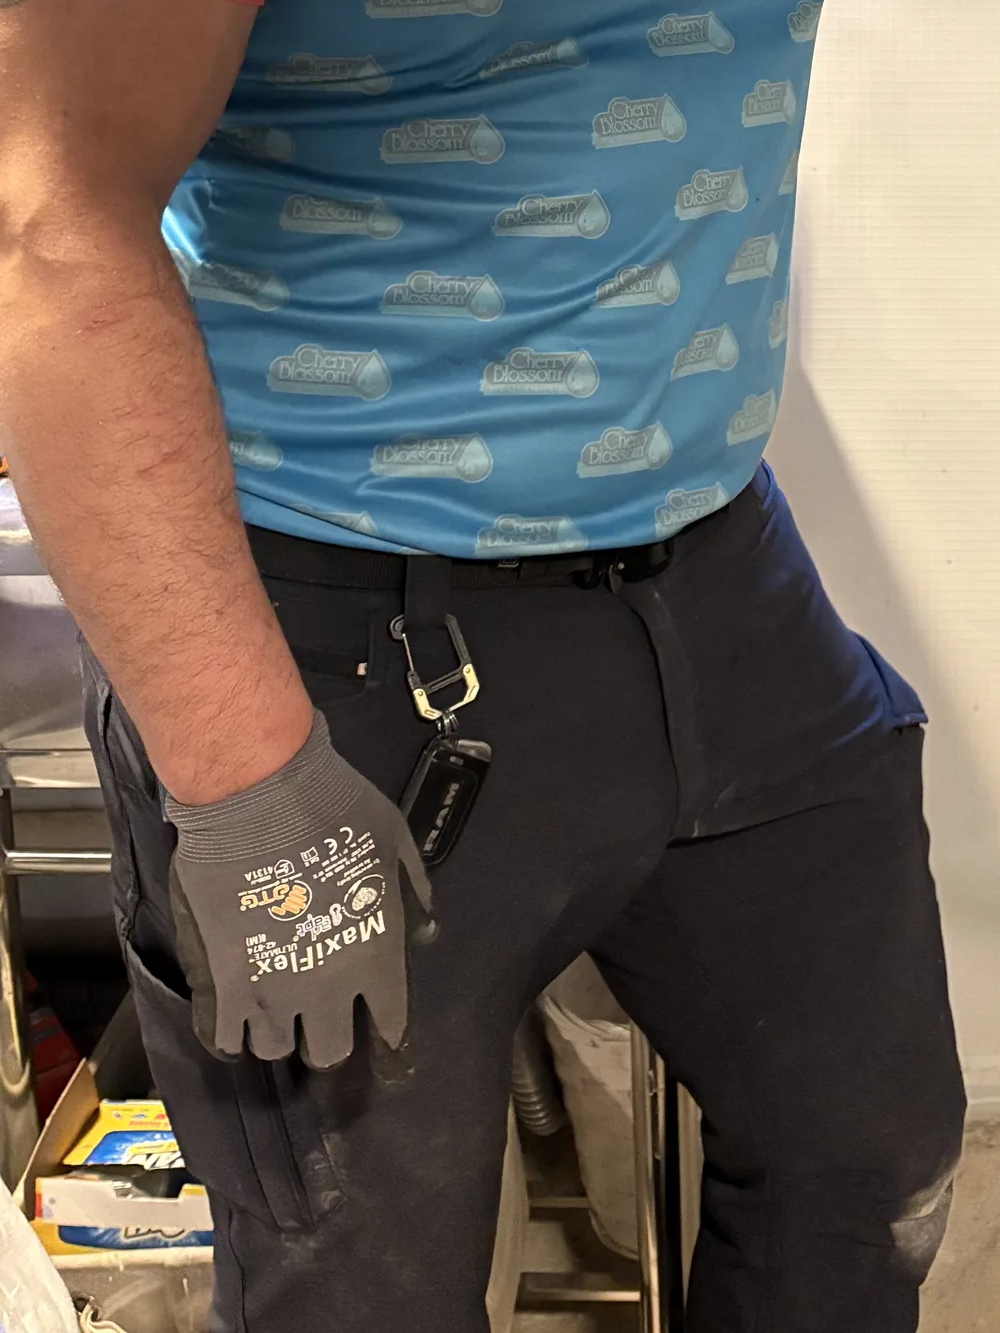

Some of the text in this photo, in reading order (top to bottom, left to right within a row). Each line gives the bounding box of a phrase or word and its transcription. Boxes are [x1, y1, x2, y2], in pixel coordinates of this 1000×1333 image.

[612, 99, 660, 120] Cherry
[406, 120, 470, 140] Cherry
[601, 116, 657, 136] Blossom
[391, 133, 465, 152] Blossom
[410, 273, 474, 294] Cherry
[392, 288, 467, 306] Blossom
[297, 347, 360, 371] Cherry
[510, 350, 575, 371] Cherry
[279, 362, 352, 383] Blossom
[492, 366, 564, 383] Blossom
[244, 866, 274, 881] 4131A
[254, 943, 298, 961] ULTIMATE
[256, 910, 386, 974] MaxiFlex
